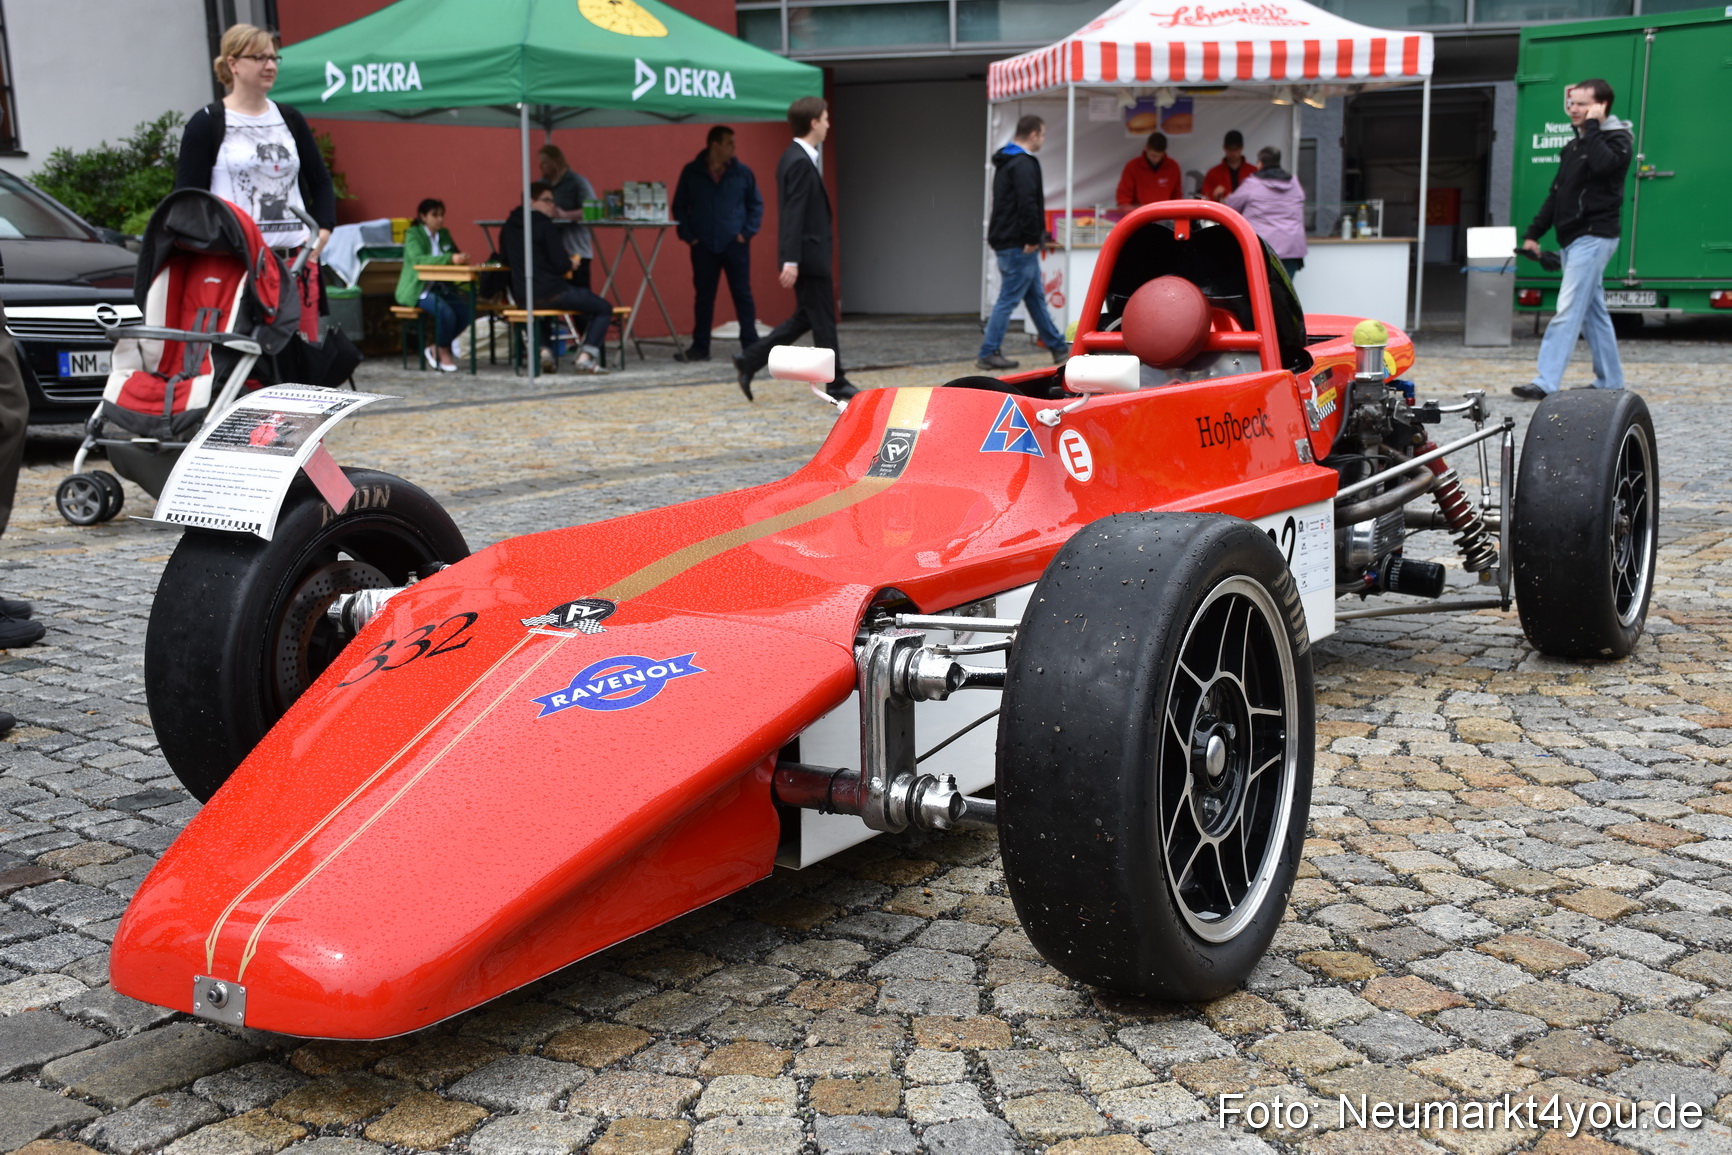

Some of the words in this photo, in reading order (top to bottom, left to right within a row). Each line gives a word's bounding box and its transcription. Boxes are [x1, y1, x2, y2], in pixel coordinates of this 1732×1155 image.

[351, 61, 423, 94] DEKRA
[664, 66, 737, 100] DEKRA
[71, 353, 98, 374] NM
[1196, 408, 1274, 450] Hofbeck
[1063, 437, 1089, 474] E
[336, 611, 479, 688] 332
[550, 662, 684, 708] RAVENOL
